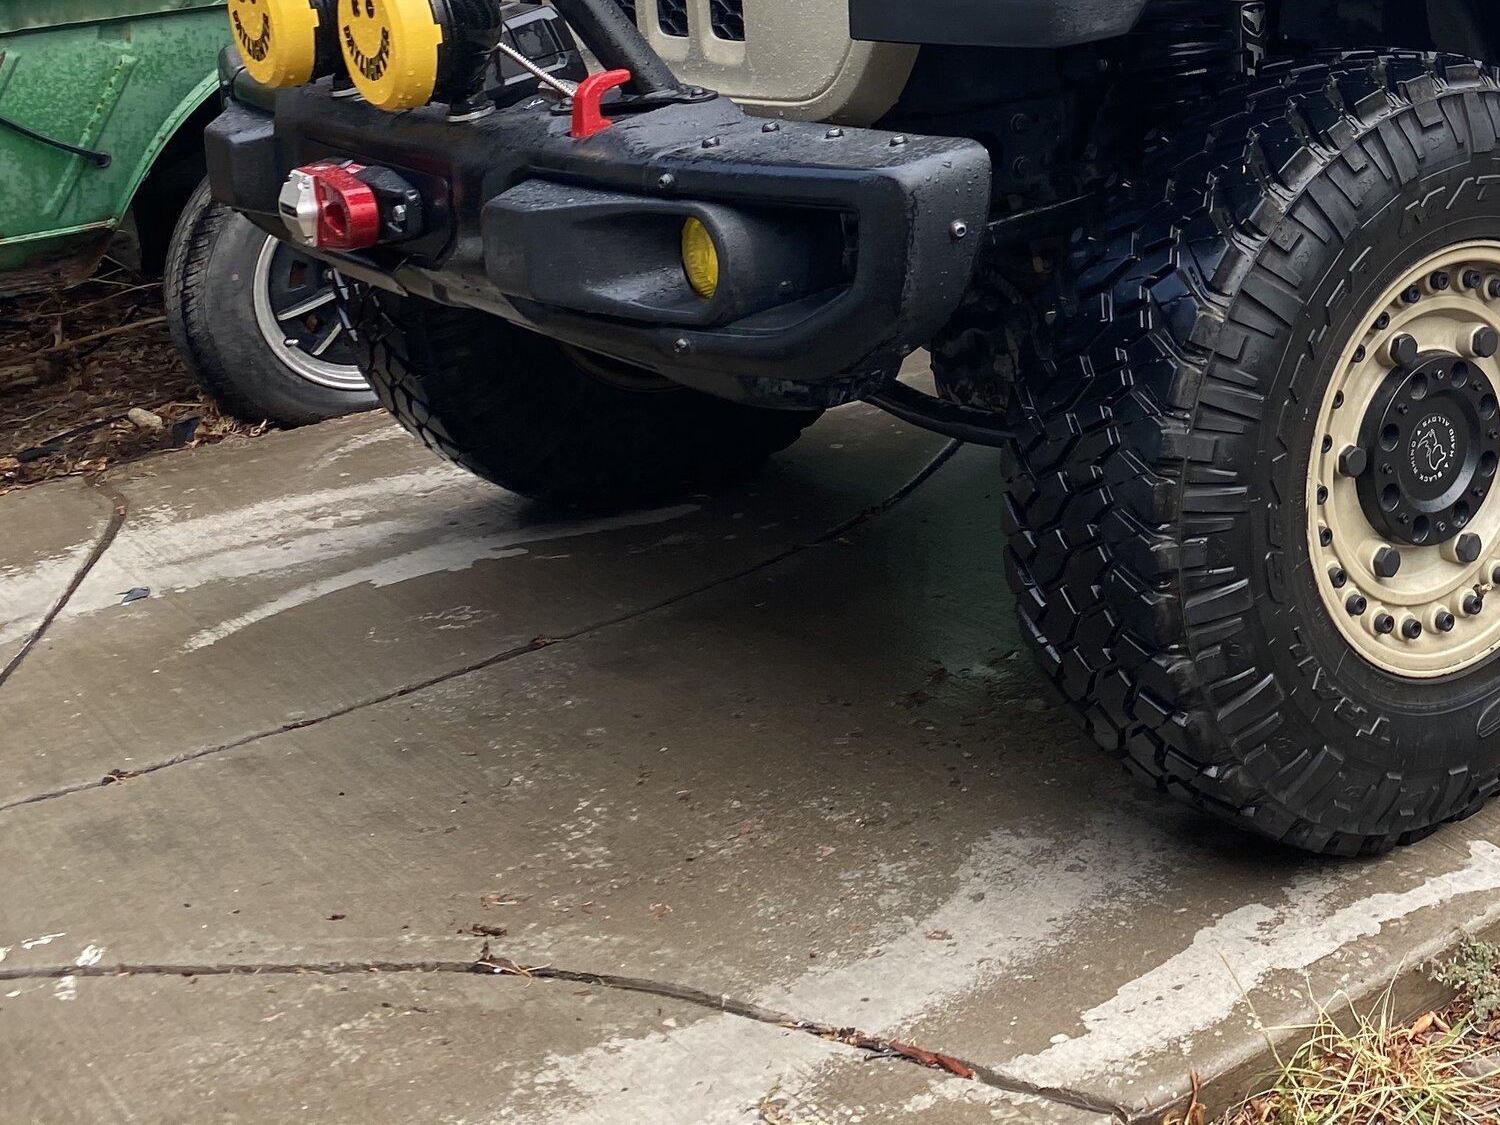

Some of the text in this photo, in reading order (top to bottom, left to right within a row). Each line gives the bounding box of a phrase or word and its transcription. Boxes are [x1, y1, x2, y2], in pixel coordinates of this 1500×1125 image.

[1421, 416, 1450, 428] ALLOYS
[1410, 440, 1443, 483] BLACK RHINO
